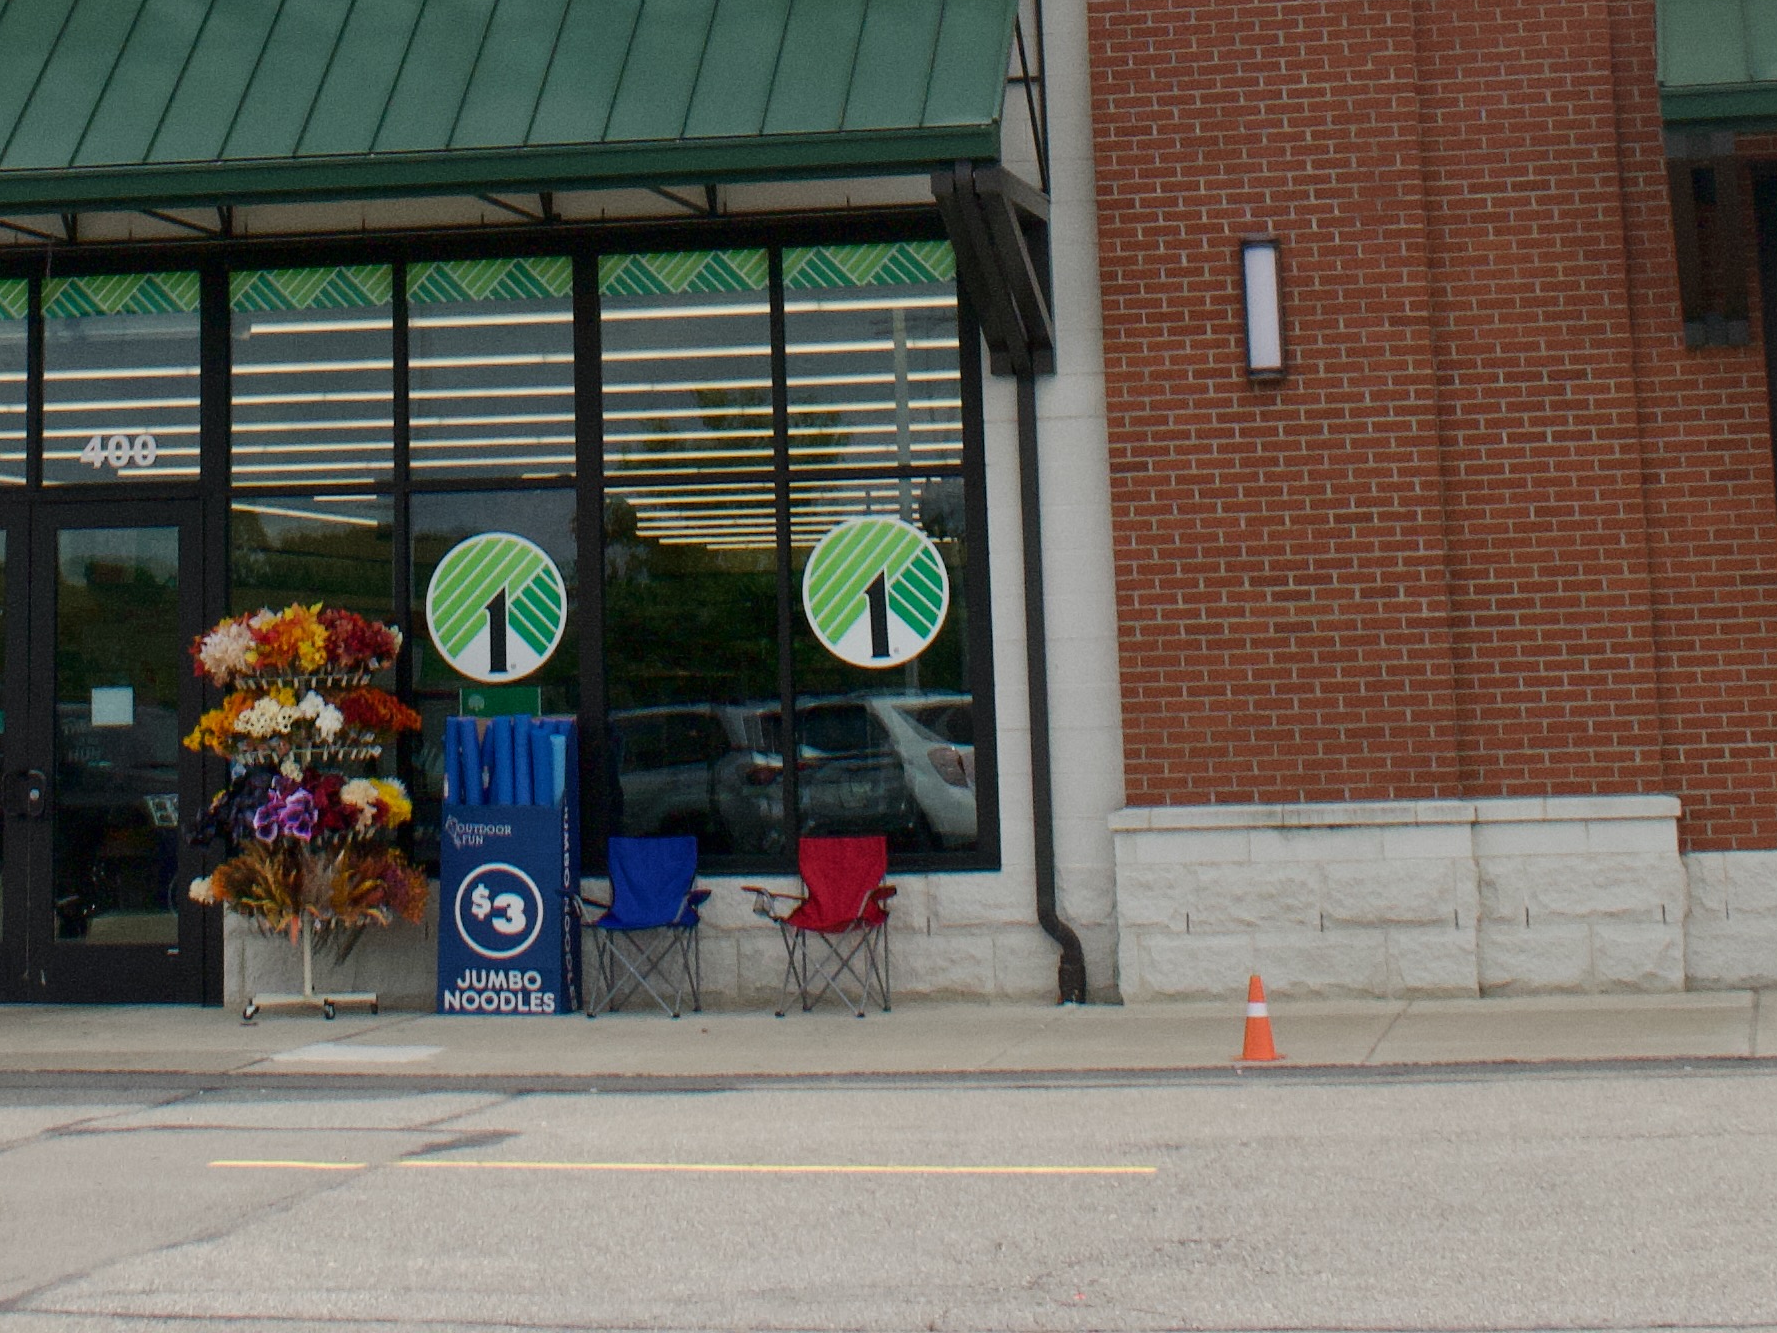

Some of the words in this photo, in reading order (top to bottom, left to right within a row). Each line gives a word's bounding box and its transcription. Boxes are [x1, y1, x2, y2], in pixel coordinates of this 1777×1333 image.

[80, 434, 157, 469] 400
[455, 823, 512, 836] OUTDOOR
[462, 835, 484, 845] FUN
[471, 883, 527, 935] $3
[457, 968, 542, 991] JUMBO
[444, 989, 556, 1013] NOODLES
